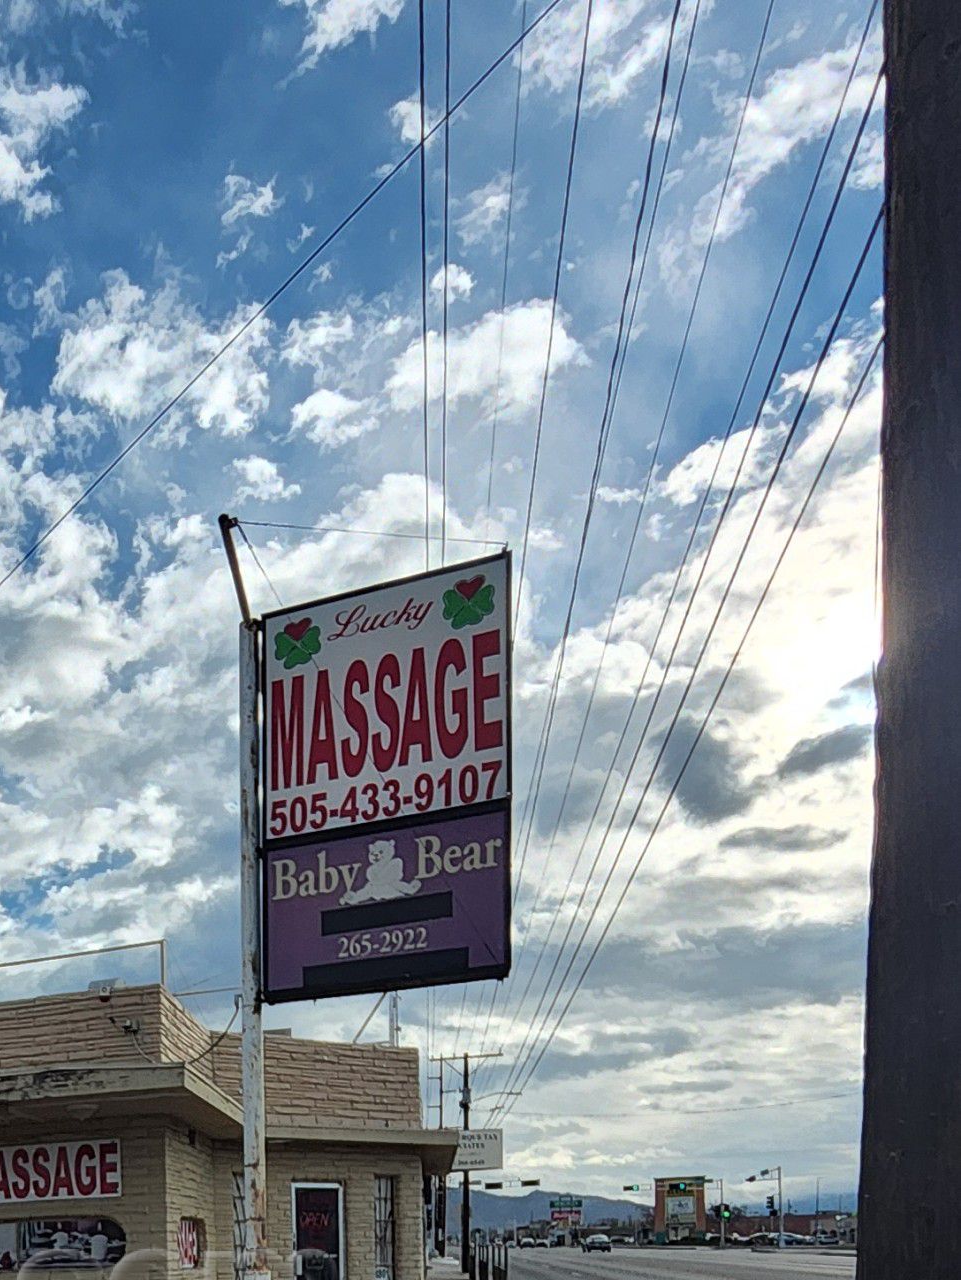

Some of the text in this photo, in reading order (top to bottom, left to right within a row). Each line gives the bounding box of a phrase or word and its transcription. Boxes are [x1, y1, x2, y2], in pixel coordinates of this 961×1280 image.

[327, 598, 434, 641] Lucky
[271, 629, 504, 791] MASSAGE
[269, 760, 503, 836] 505-433-9107
[271, 835, 503, 901] Baby Bear
[338, 927, 428, 958] 265-2922
